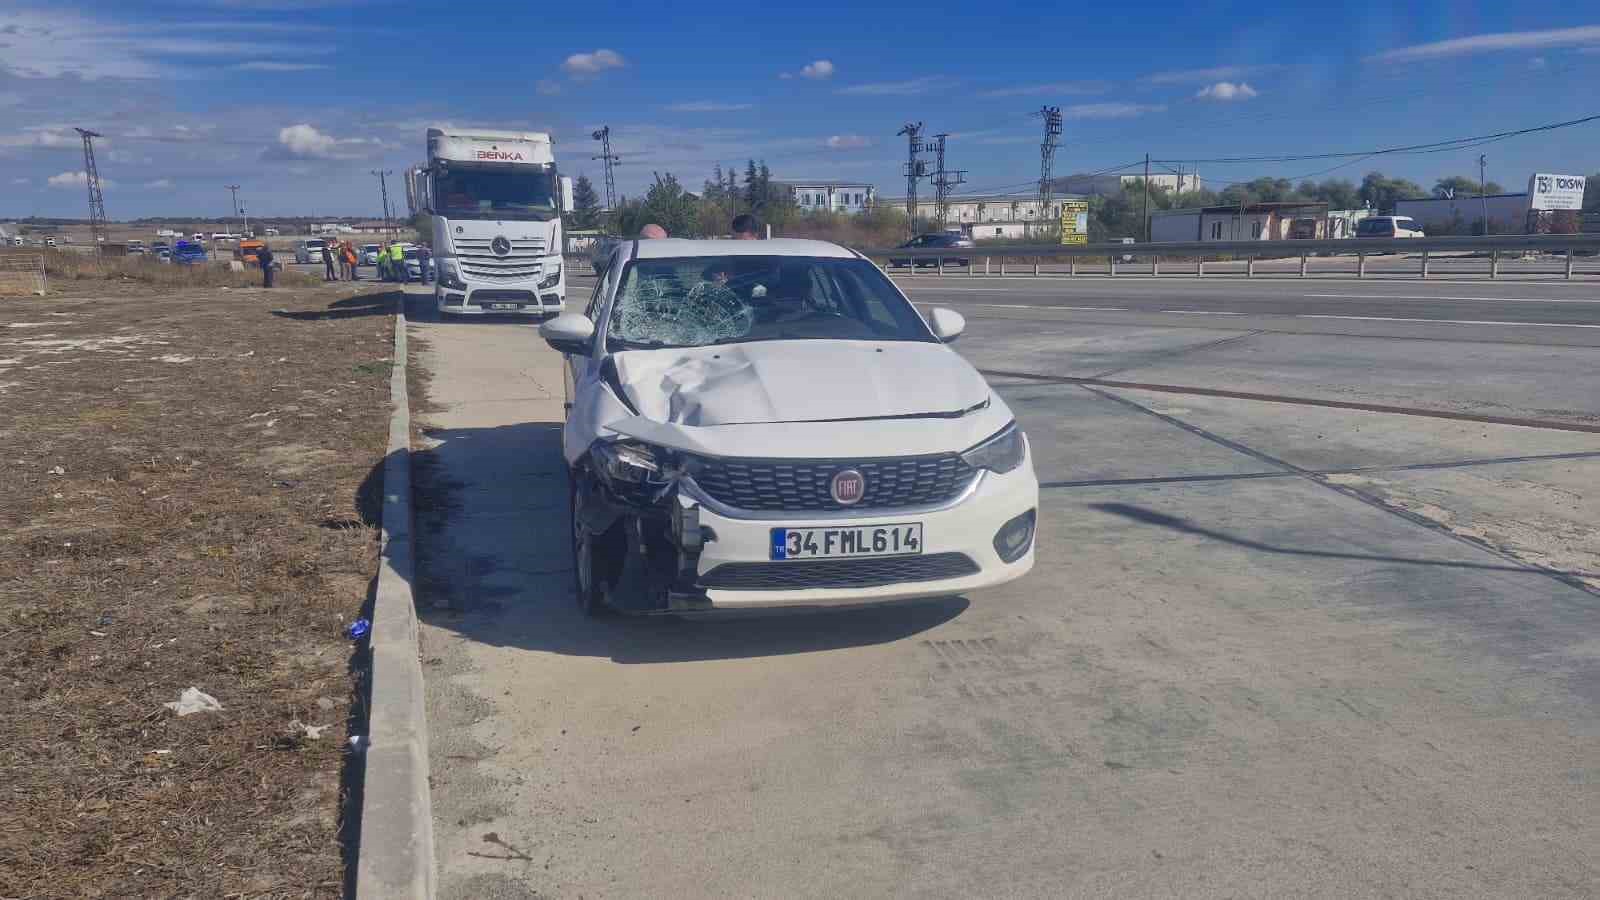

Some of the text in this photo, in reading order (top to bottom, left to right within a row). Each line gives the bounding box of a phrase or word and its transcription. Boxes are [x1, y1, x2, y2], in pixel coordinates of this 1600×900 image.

[476, 151, 524, 161] BENKA
[838, 479, 857, 497] FIAT
[786, 531, 818, 555] 34
